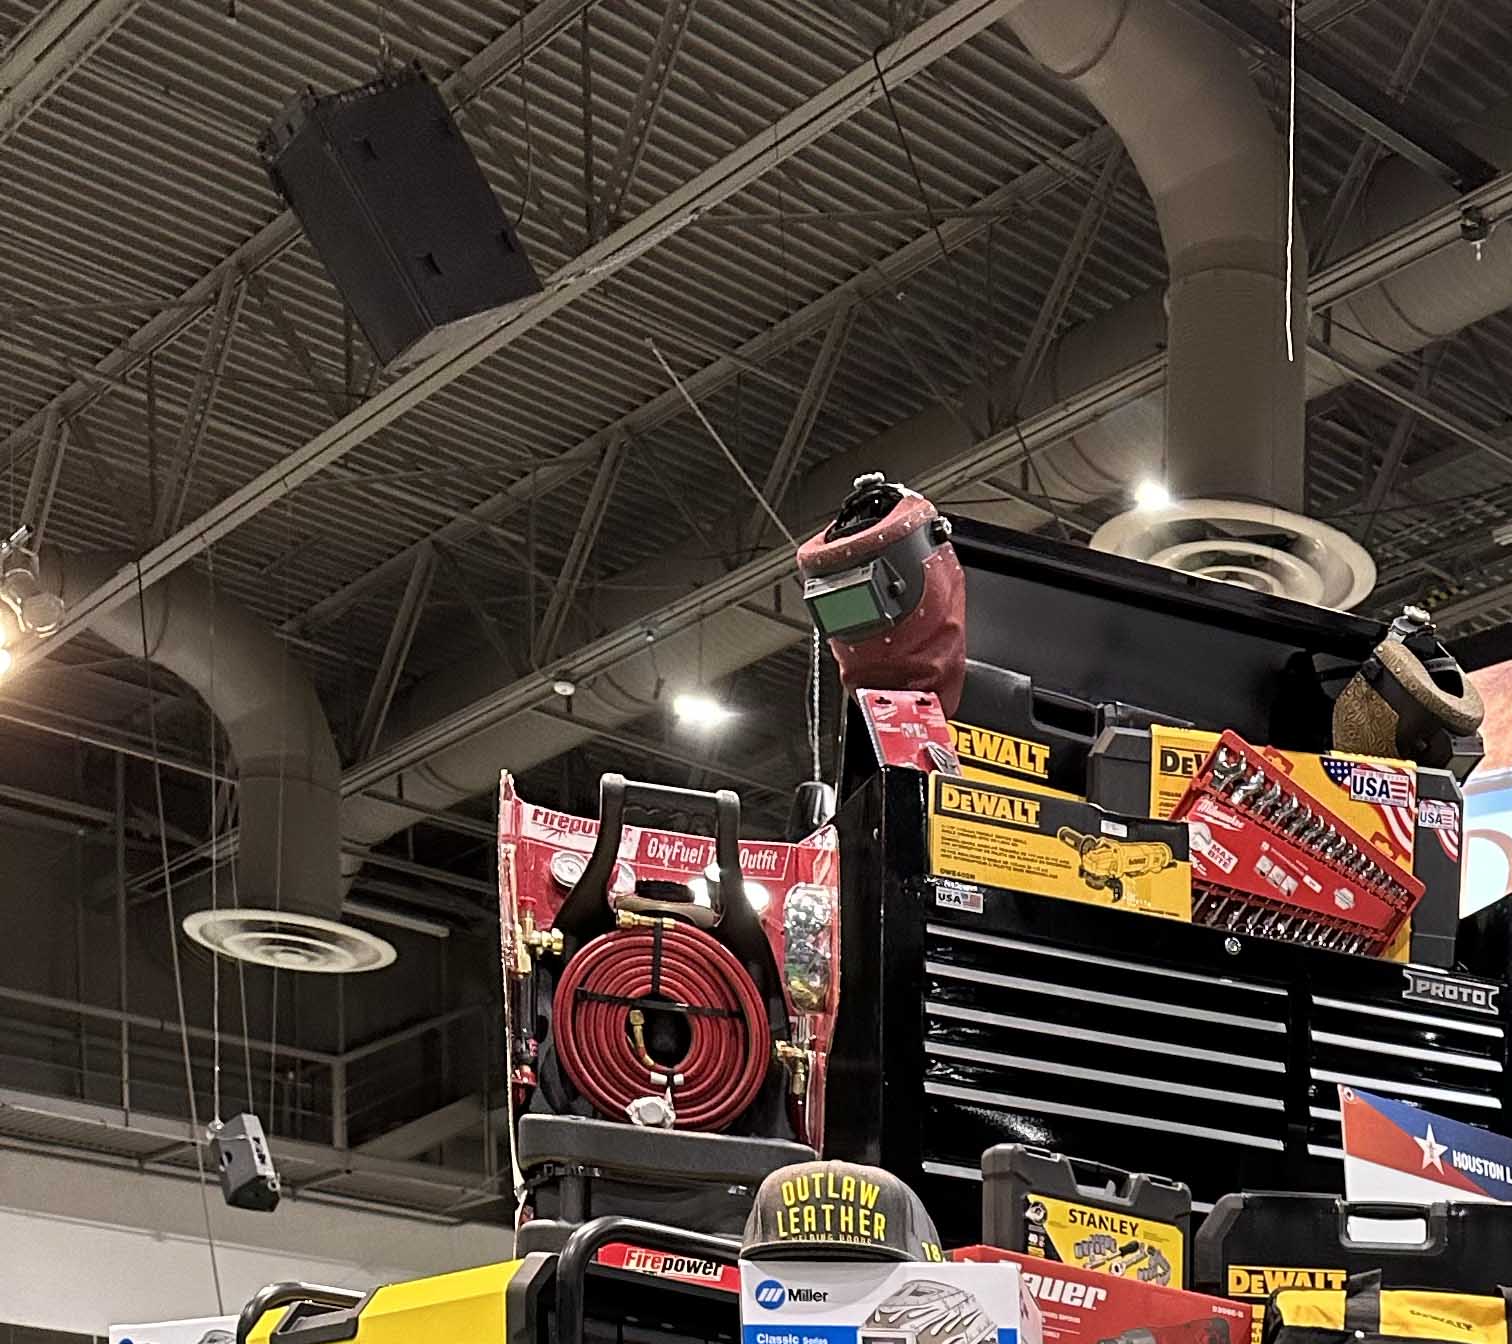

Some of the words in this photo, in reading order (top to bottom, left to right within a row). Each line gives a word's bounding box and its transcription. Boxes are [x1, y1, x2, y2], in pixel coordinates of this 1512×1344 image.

[1352, 776, 1391, 799] USA
[941, 785, 1040, 826] DEWALT
[1420, 808, 1443, 825] USA
[648, 837, 704, 866] OxyFuel
[740, 848, 778, 871] Outfit
[1211, 843, 1233, 863] MAX
[938, 893, 962, 905] USA
[1416, 978, 1487, 1006] PROTO
[1452, 1150, 1505, 1182] HOUSTON
[781, 1172, 881, 1210] OUTLAW
[776, 1205, 887, 1242] LEATHER
[1068, 1208, 1140, 1237] STANLEY
[625, 1249, 722, 1277] Firepower
[788, 1288, 828, 1303] Miller
[1017, 1270, 1108, 1311] auer
